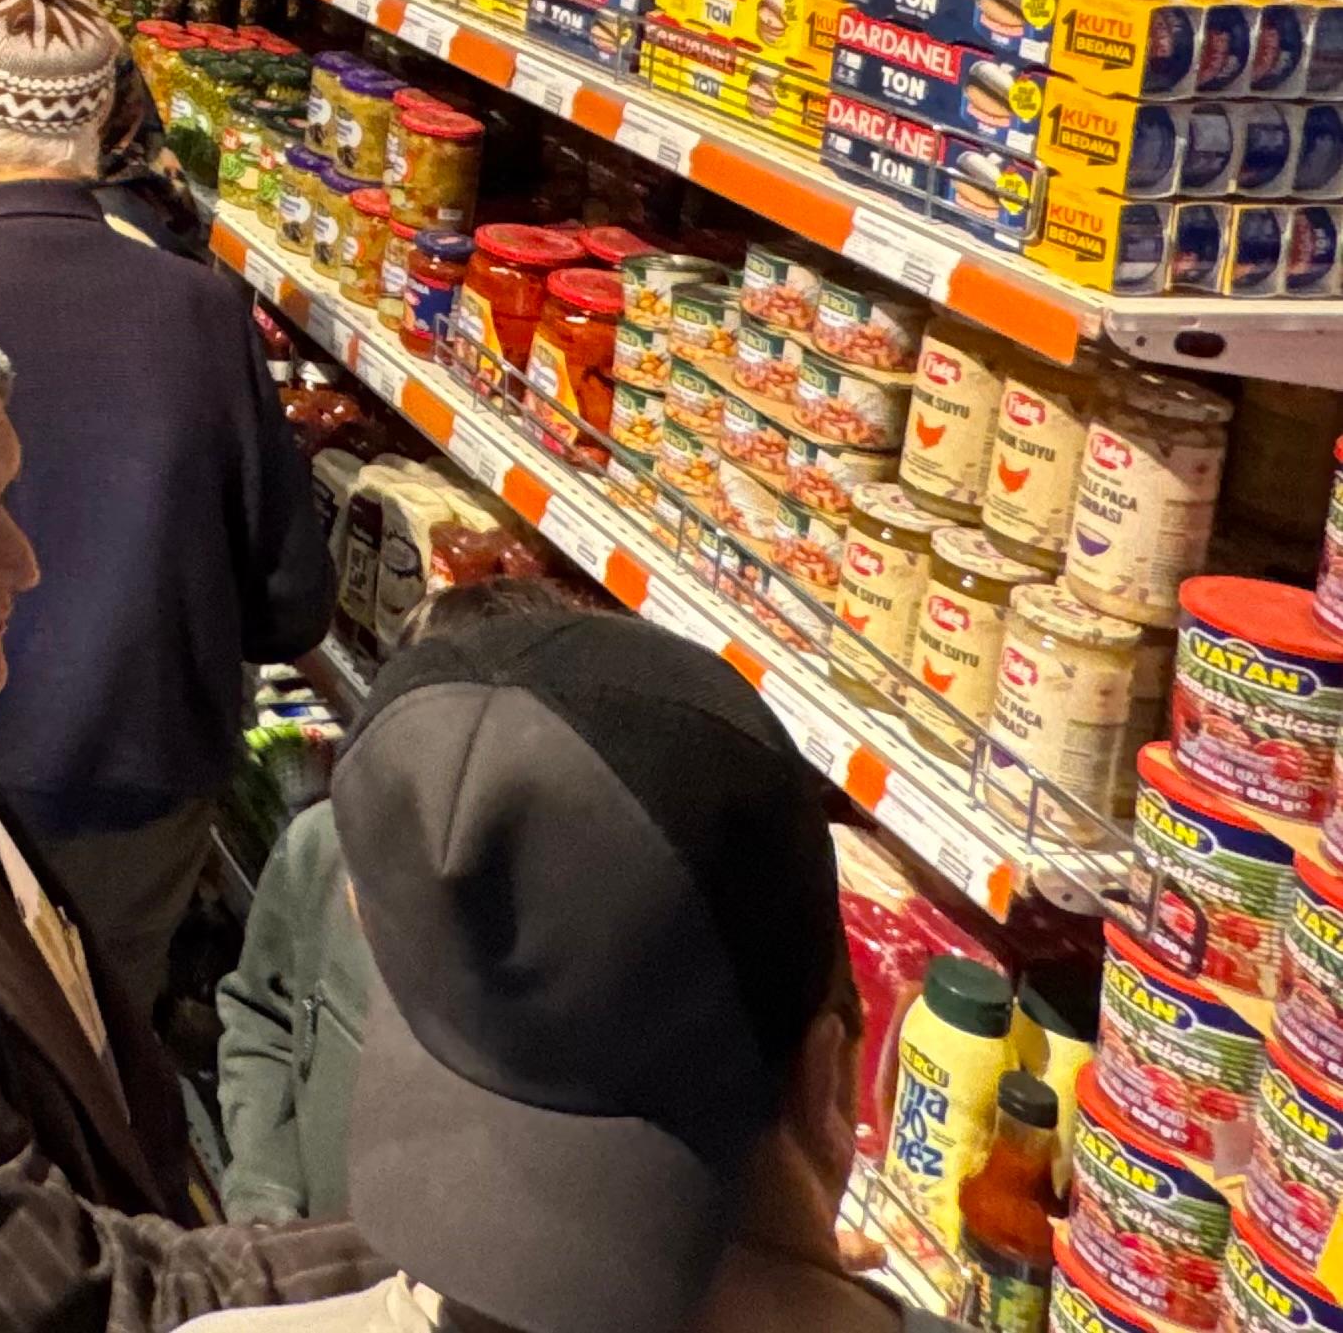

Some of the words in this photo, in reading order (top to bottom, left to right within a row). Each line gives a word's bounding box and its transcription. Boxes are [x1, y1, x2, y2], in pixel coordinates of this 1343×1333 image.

[705, 0, 733, 26] TON
[1077, 13, 1134, 39] KUTU
[838, 18, 955, 78] DARDANEL
[1076, 37, 1132, 62] BEDAVA
[880, 66, 926, 100] TON
[1062, 107, 1119, 136] KUTU
[1061, 130, 1116, 158] BEDAVA
[1048, 201, 1104, 234] KUTU
[1047, 223, 1103, 255] BEDAVA
[936, 396, 970, 420] SUYU
[1007, 394, 1043, 423] Fide
[1019, 439, 1056, 462] SUYU
[1092, 437, 1129, 466] Fide
[1101, 486, 1138, 513] PAÇA
[859, 585, 892, 611] SUYU
[943, 641, 980, 668] SUYU
[1194, 635, 1300, 695] VATAN
[1011, 702, 1043, 730] PAÇA
[1137, 797, 1200, 848] ATAN
